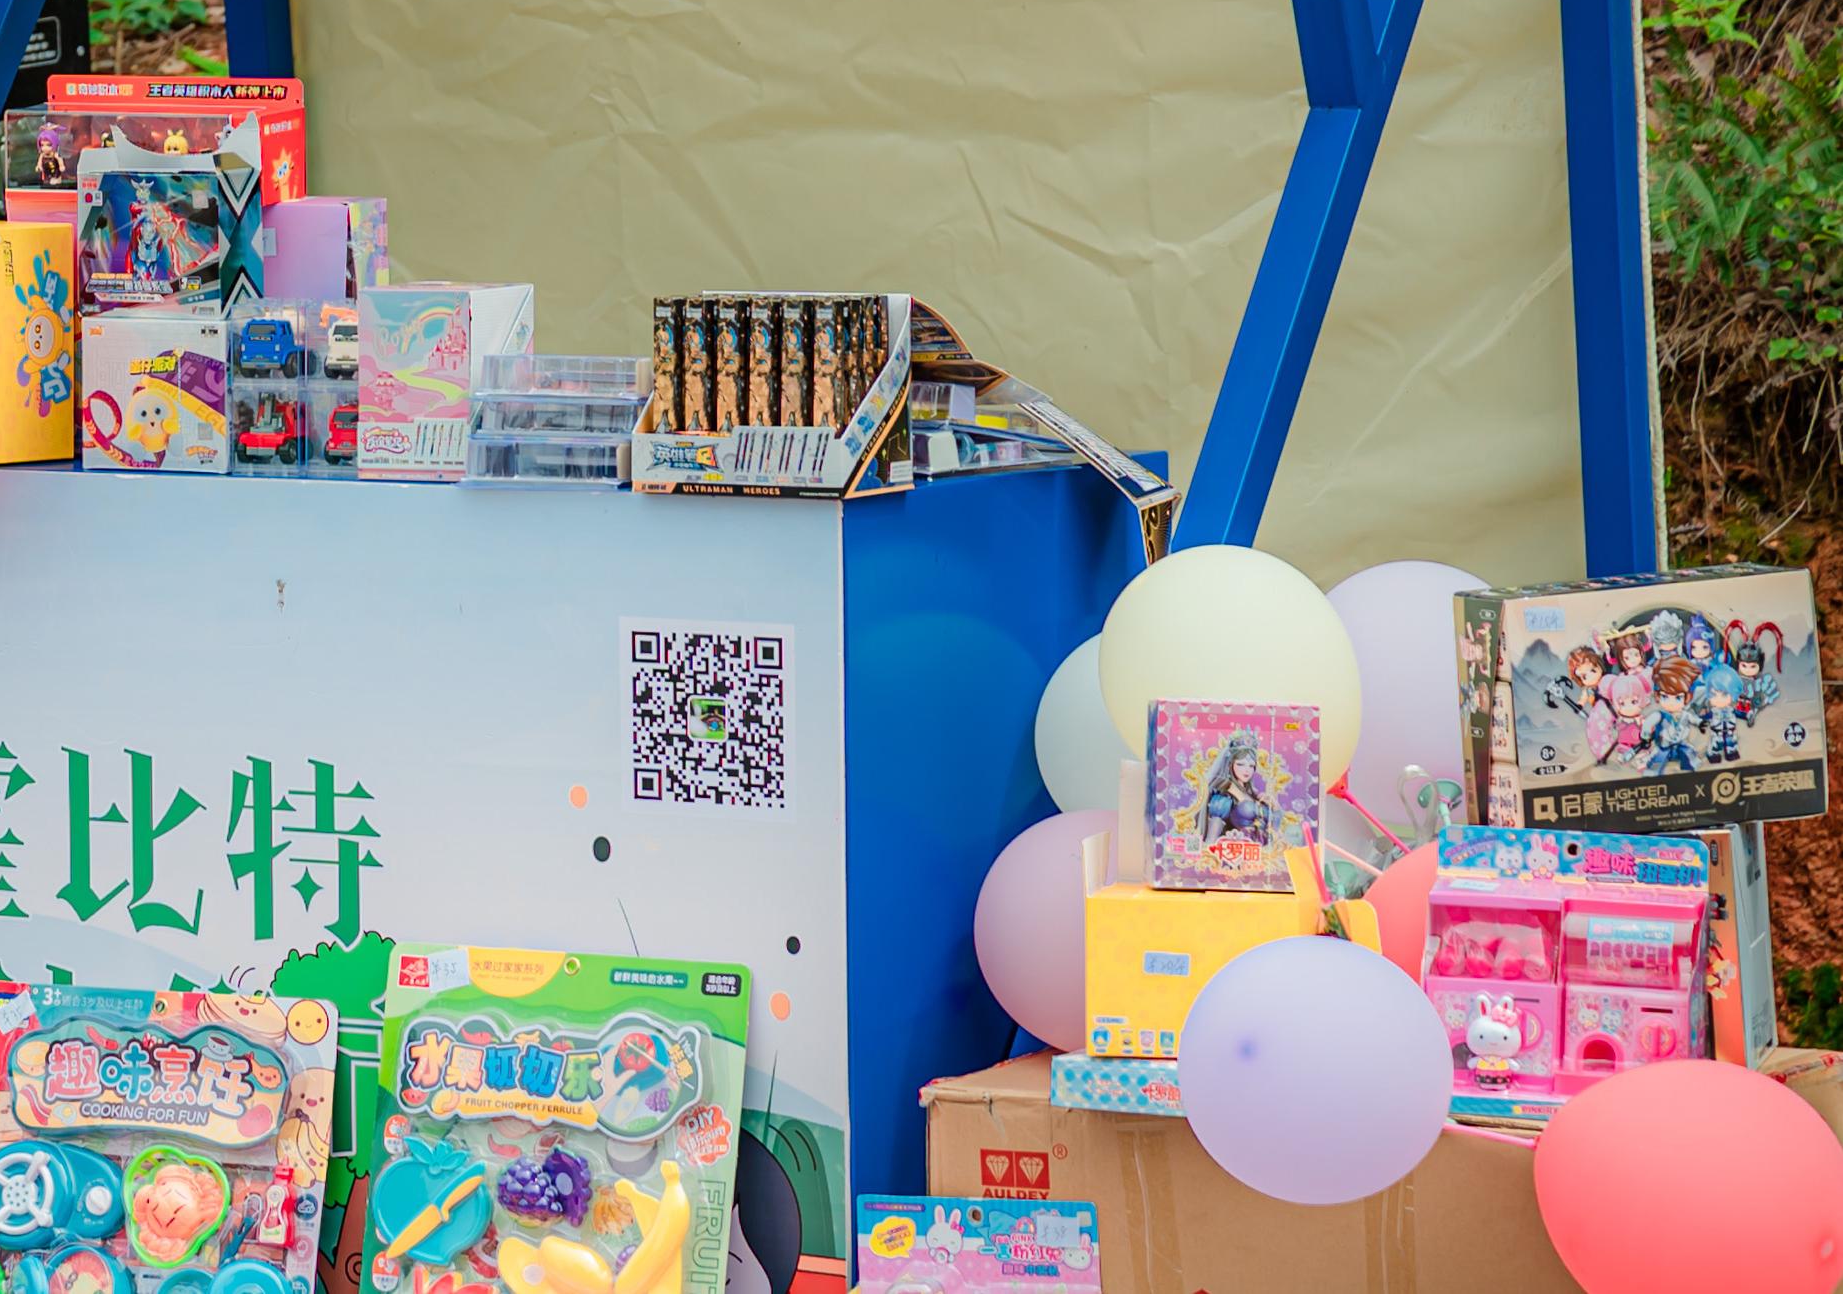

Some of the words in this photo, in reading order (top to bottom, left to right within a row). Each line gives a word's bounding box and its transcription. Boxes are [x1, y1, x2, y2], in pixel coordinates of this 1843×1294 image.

[682, 484, 734, 495] ULTRAMAN
[743, 486, 781, 496] HEROES
[1560, 791, 1604, 819] 启蒙
[1606, 784, 1668, 801] LIGHTEN
[1607, 798, 1637, 813] THE
[1638, 793, 1690, 811] DREAM
[471, 960, 545, 977] 水果过家家系列
[408, 1031, 604, 1100] 水果切切乐
[44, 1037, 253, 1117] 趣味烹饪
[81, 1102, 144, 1121] COOKING
[146, 1106, 176, 1123] FOR
[179, 1109, 209, 1125] FUN
[465, 1097, 492, 1110] FRUIT
[495, 1099, 540, 1113] CHOPPER
[542, 1102, 584, 1116] FERRULE
[686, 1109, 716, 1134] DIY
[982, 1187, 1050, 1201] AULDEY
